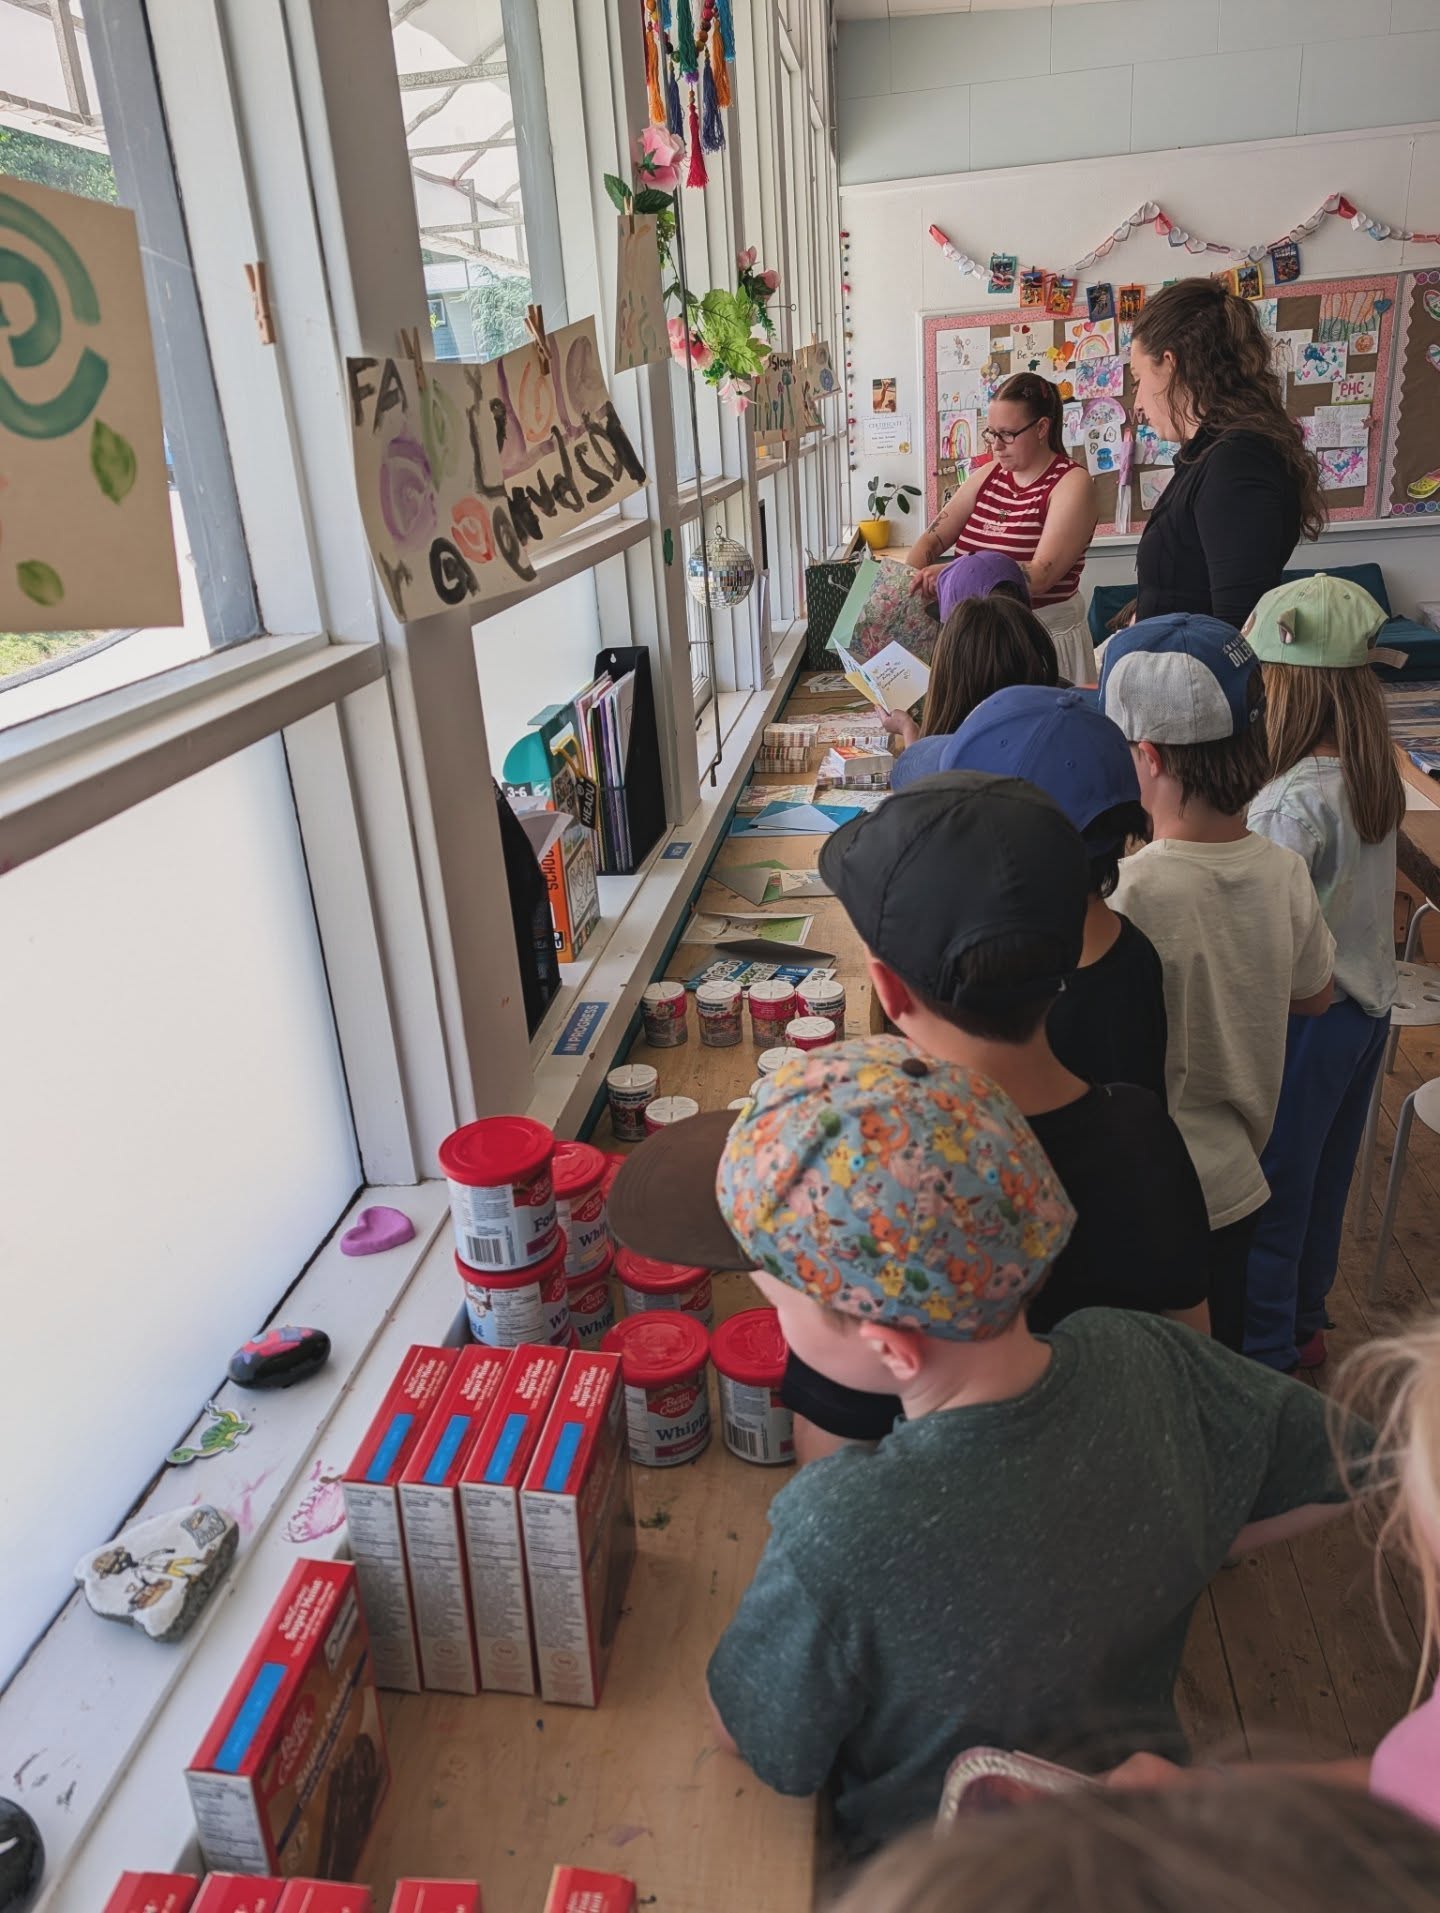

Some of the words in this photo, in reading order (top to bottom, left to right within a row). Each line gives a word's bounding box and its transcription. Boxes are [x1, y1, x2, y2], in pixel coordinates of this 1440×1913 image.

[1340, 381, 1365, 396] PHC
[507, 787, 528, 797] 3-6
[582, 783, 596, 825] HEADU
[567, 1004, 600, 1042] PROGRESS
